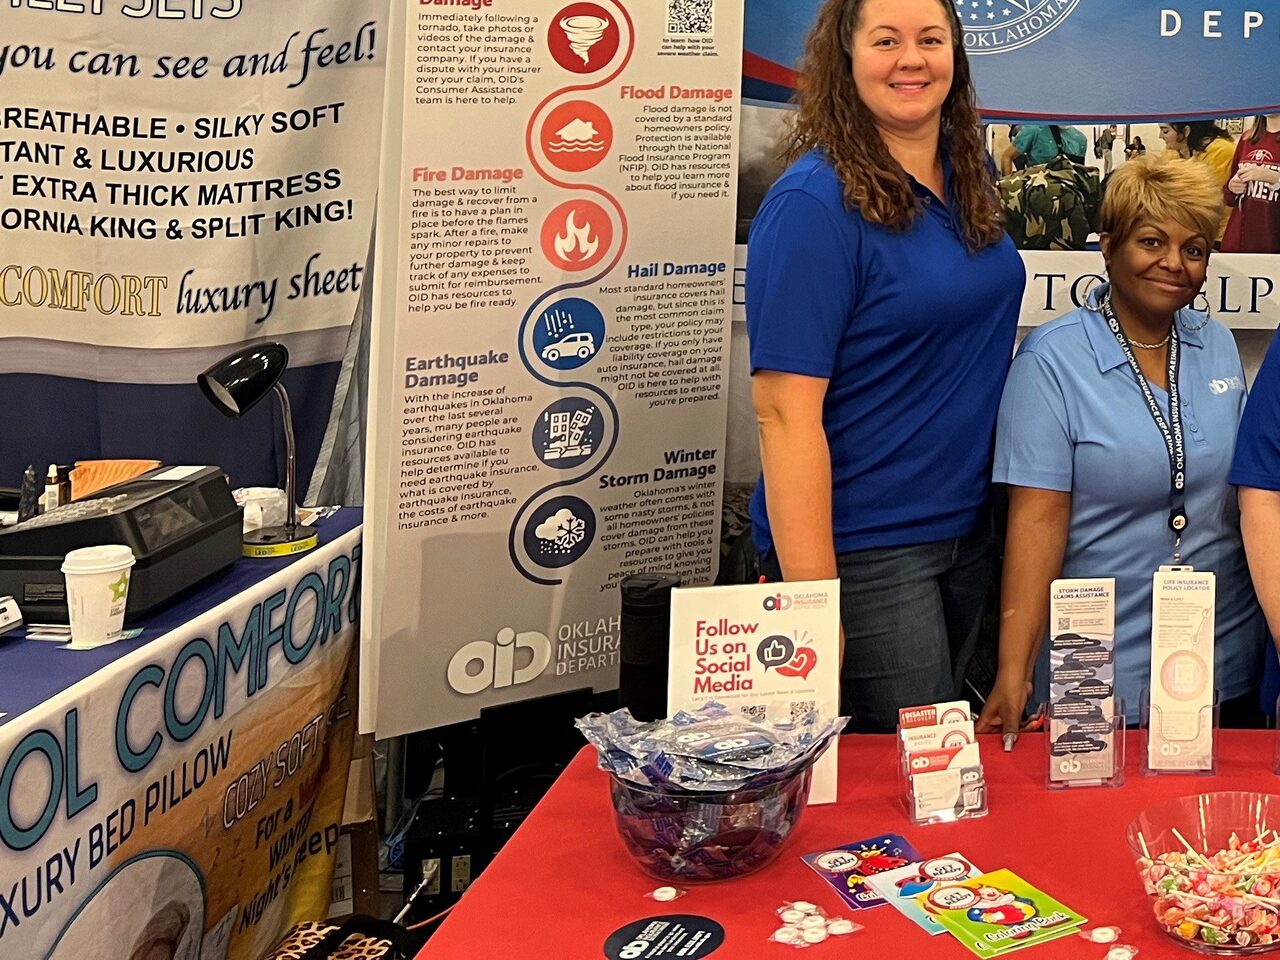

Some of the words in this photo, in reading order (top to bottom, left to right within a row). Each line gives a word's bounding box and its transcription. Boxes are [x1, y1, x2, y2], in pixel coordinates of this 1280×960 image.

[418, 12, 483, 24] Immediately
[484, 13, 530, 25] following
[418, 23, 461, 32] tornado,
[463, 23, 486, 32] take
[487, 24, 522, 33] photos
[416, 44, 456, 52] contact
[457, 45, 481, 54] your
[483, 44, 532, 53] insurance
[417, 33, 451, 42] videos
[452, 33, 463, 42] of
[465, 34, 482, 43] the
[484, 34, 525, 44] damage
[527, 34, 535, 43] &
[68, 52, 140, 77] can
[154, 53, 209, 79] see
[223, 31, 301, 79] and
[287, 22, 376, 88] feel!
[620, 85, 665, 99] Flood
[669, 85, 733, 103] Damage
[0, 107, 167, 139] REATHABLE
[193, 113, 266, 139] SILKY
[271, 102, 345, 135] SOFT
[0, 141, 65, 167] TANT
[73, 147, 92, 169] &
[101, 148, 254, 173] LUXURIOUS
[412, 166, 447, 182] Fire
[451, 166, 523, 184] Damage
[12, 174, 98, 204] EXTRA
[105, 182, 190, 207] THICK
[197, 168, 341, 206] MATTRESS
[0, 208, 84, 236] ORNIA
[90, 215, 157, 240] KING
[165, 218, 184, 240] &
[191, 213, 266, 240] SPLIT
[275, 199, 354, 232] KING!
[627, 262, 658, 278] Hail
[662, 262, 726, 277] Damage
[0, 264, 168, 318] COMFORT
[176, 268, 278, 324] luxury
[287, 252, 366, 300] sheet
[405, 349, 509, 372] Earthquake
[404, 371, 479, 389] Damage
[663, 448, 717, 465] Winter
[599, 472, 649, 489] Storm
[652, 464, 716, 482] Damage
[1075, 591, 1110, 599] ASSISTANCE
[558, 616, 621, 642] OKLAH
[696, 618, 760, 637] Follow
[557, 634, 620, 660] INSUR
[696, 639, 718, 656] Us
[722, 641, 746, 654] on
[556, 651, 620, 676] DEPART
[695, 654, 751, 675] Social
[693, 673, 753, 694] Media
[223, 750, 274, 829] COZY
[274, 714, 324, 789] SOFT
[89, 798, 137, 871] BED
[143, 730, 234, 827] PILLOW
[256, 814, 280, 849] For
[284, 798, 294, 821] a
